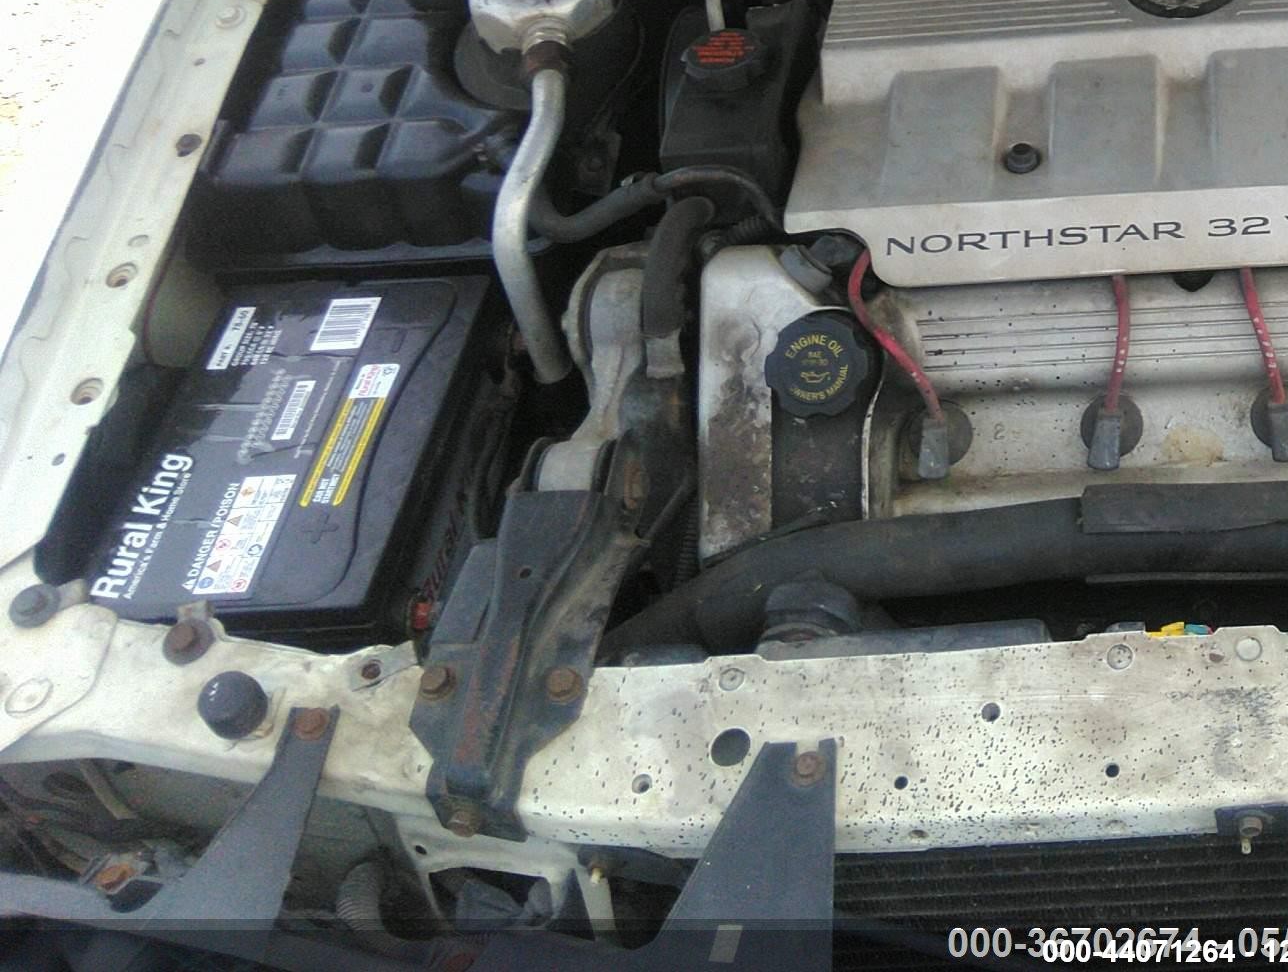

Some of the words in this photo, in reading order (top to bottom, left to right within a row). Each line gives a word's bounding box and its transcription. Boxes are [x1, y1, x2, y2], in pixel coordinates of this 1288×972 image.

[885, 221, 1184, 256] NORTHSTAR
[1207, 216, 1270, 238] 32
[785, 334, 828, 358] ENGINE
[828, 340, 844, 358] OIL
[826, 364, 848, 397] MANUAL
[173, 472, 192, 495] Store
[161, 498, 181, 521] Home
[90, 522, 153, 599] Rural
[131, 453, 194, 515] King
[156, 522, 167, 530] &
[145, 530, 164, 553] Farm
[187, 530, 219, 577] DANGER
[122, 556, 152, 599] America's
